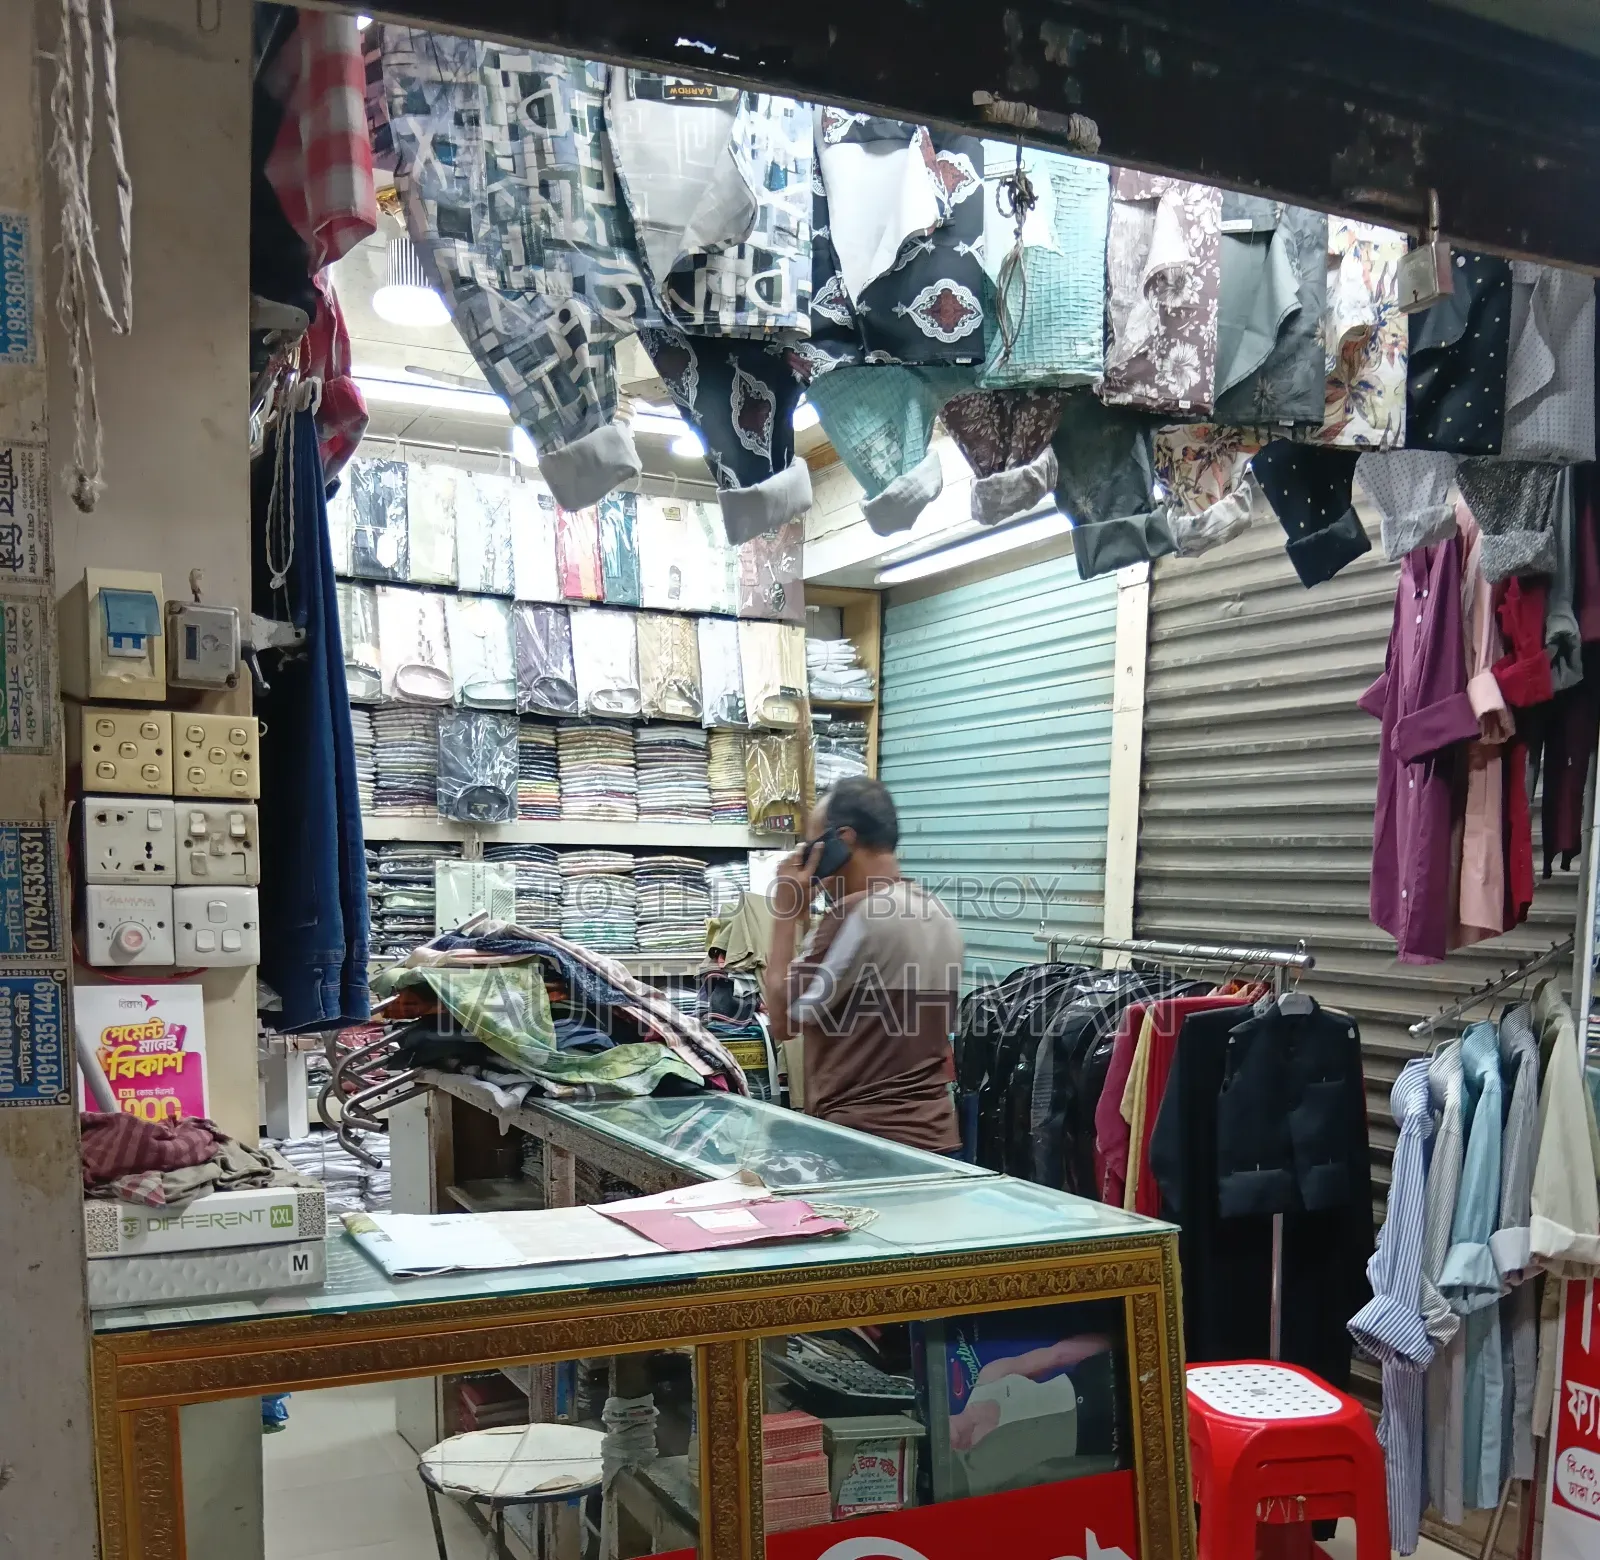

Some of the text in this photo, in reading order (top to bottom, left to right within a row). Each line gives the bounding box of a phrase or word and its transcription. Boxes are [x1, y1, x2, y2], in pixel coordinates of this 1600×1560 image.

[20, 831, 50, 951] 01794536331
[33, 980, 59, 1095] 01916351449
[101, 1017, 165, 1045] পেমেন্ট
[139, 1034, 179, 1053] মানেই
[107, 1044, 186, 1081] বিকাশ
[147, 1208, 265, 1233] DIFFERENT
[272, 1208, 292, 1224] XXL
[292, 1254, 309, 1272] M
